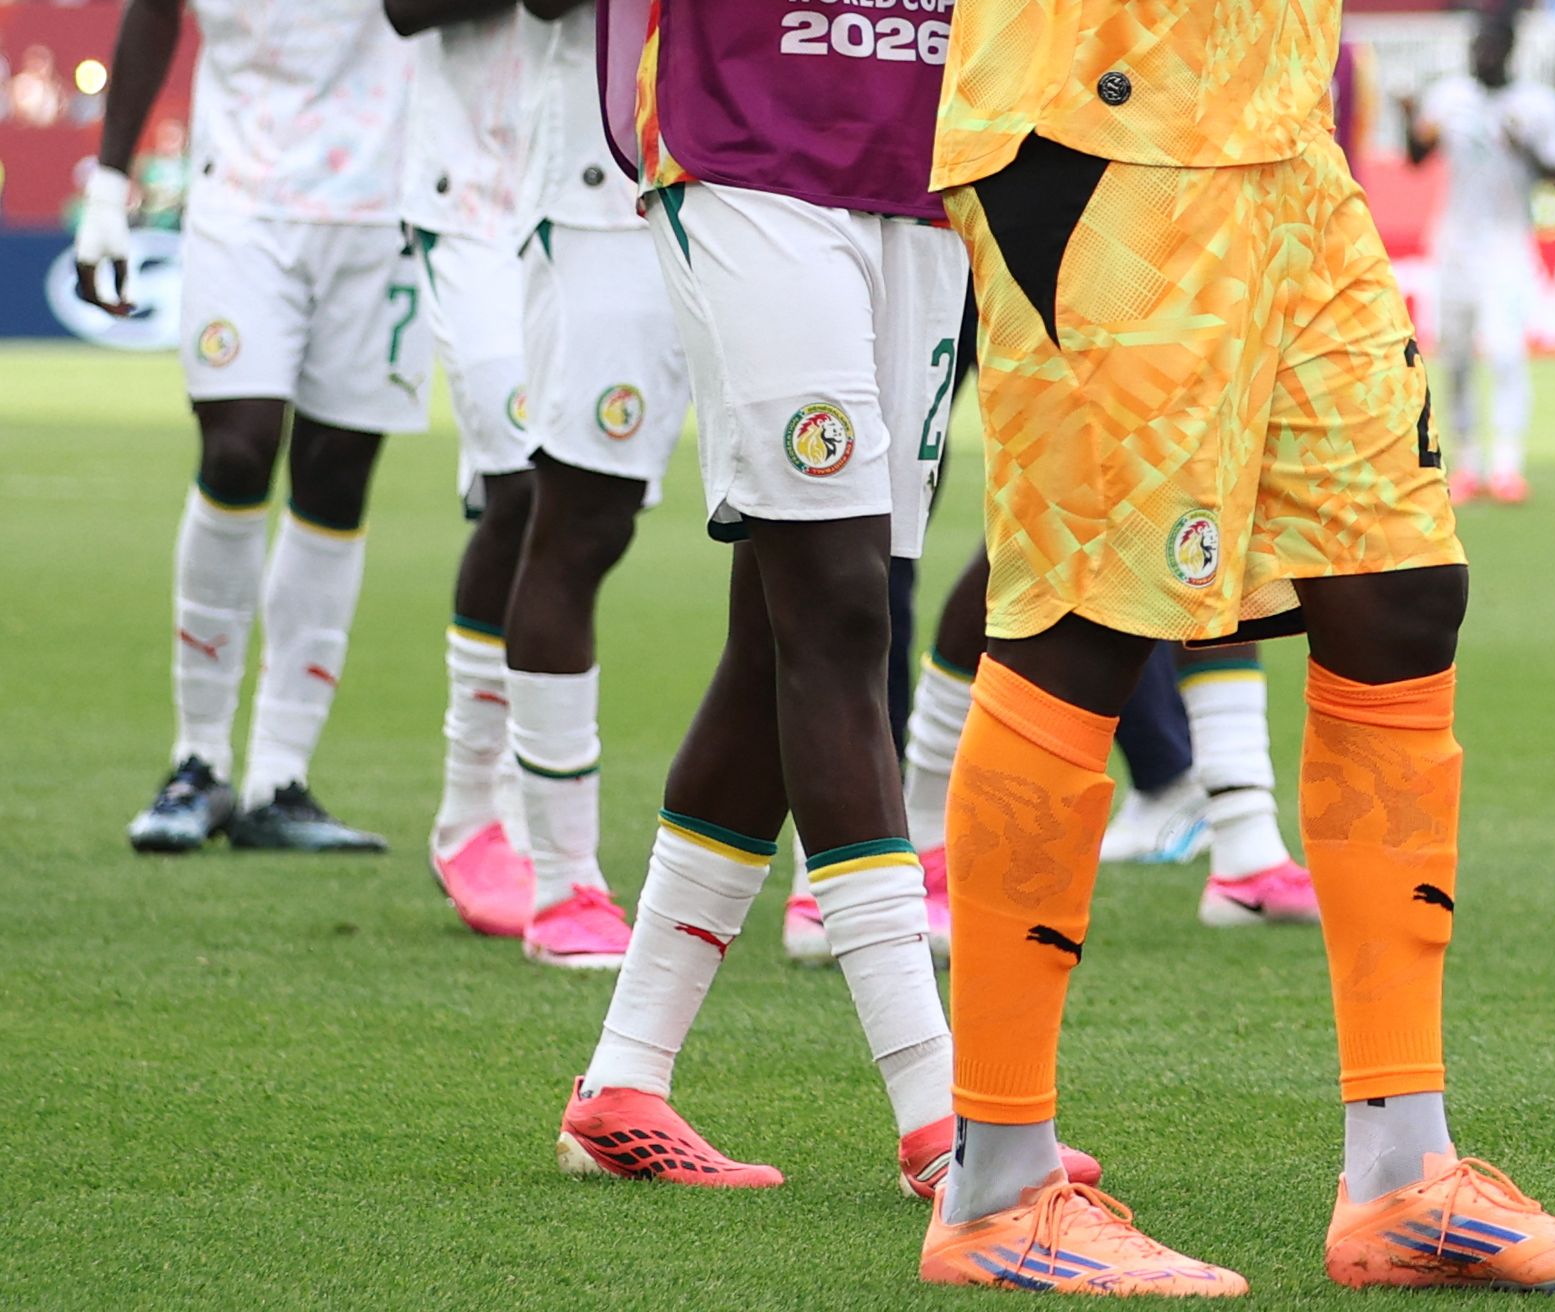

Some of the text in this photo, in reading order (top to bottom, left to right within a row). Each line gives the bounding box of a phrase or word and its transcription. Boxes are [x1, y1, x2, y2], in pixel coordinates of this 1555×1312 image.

[780, 10, 952, 66] 2026
[387, 283, 417, 365] 7
[917, 338, 955, 460] 2
